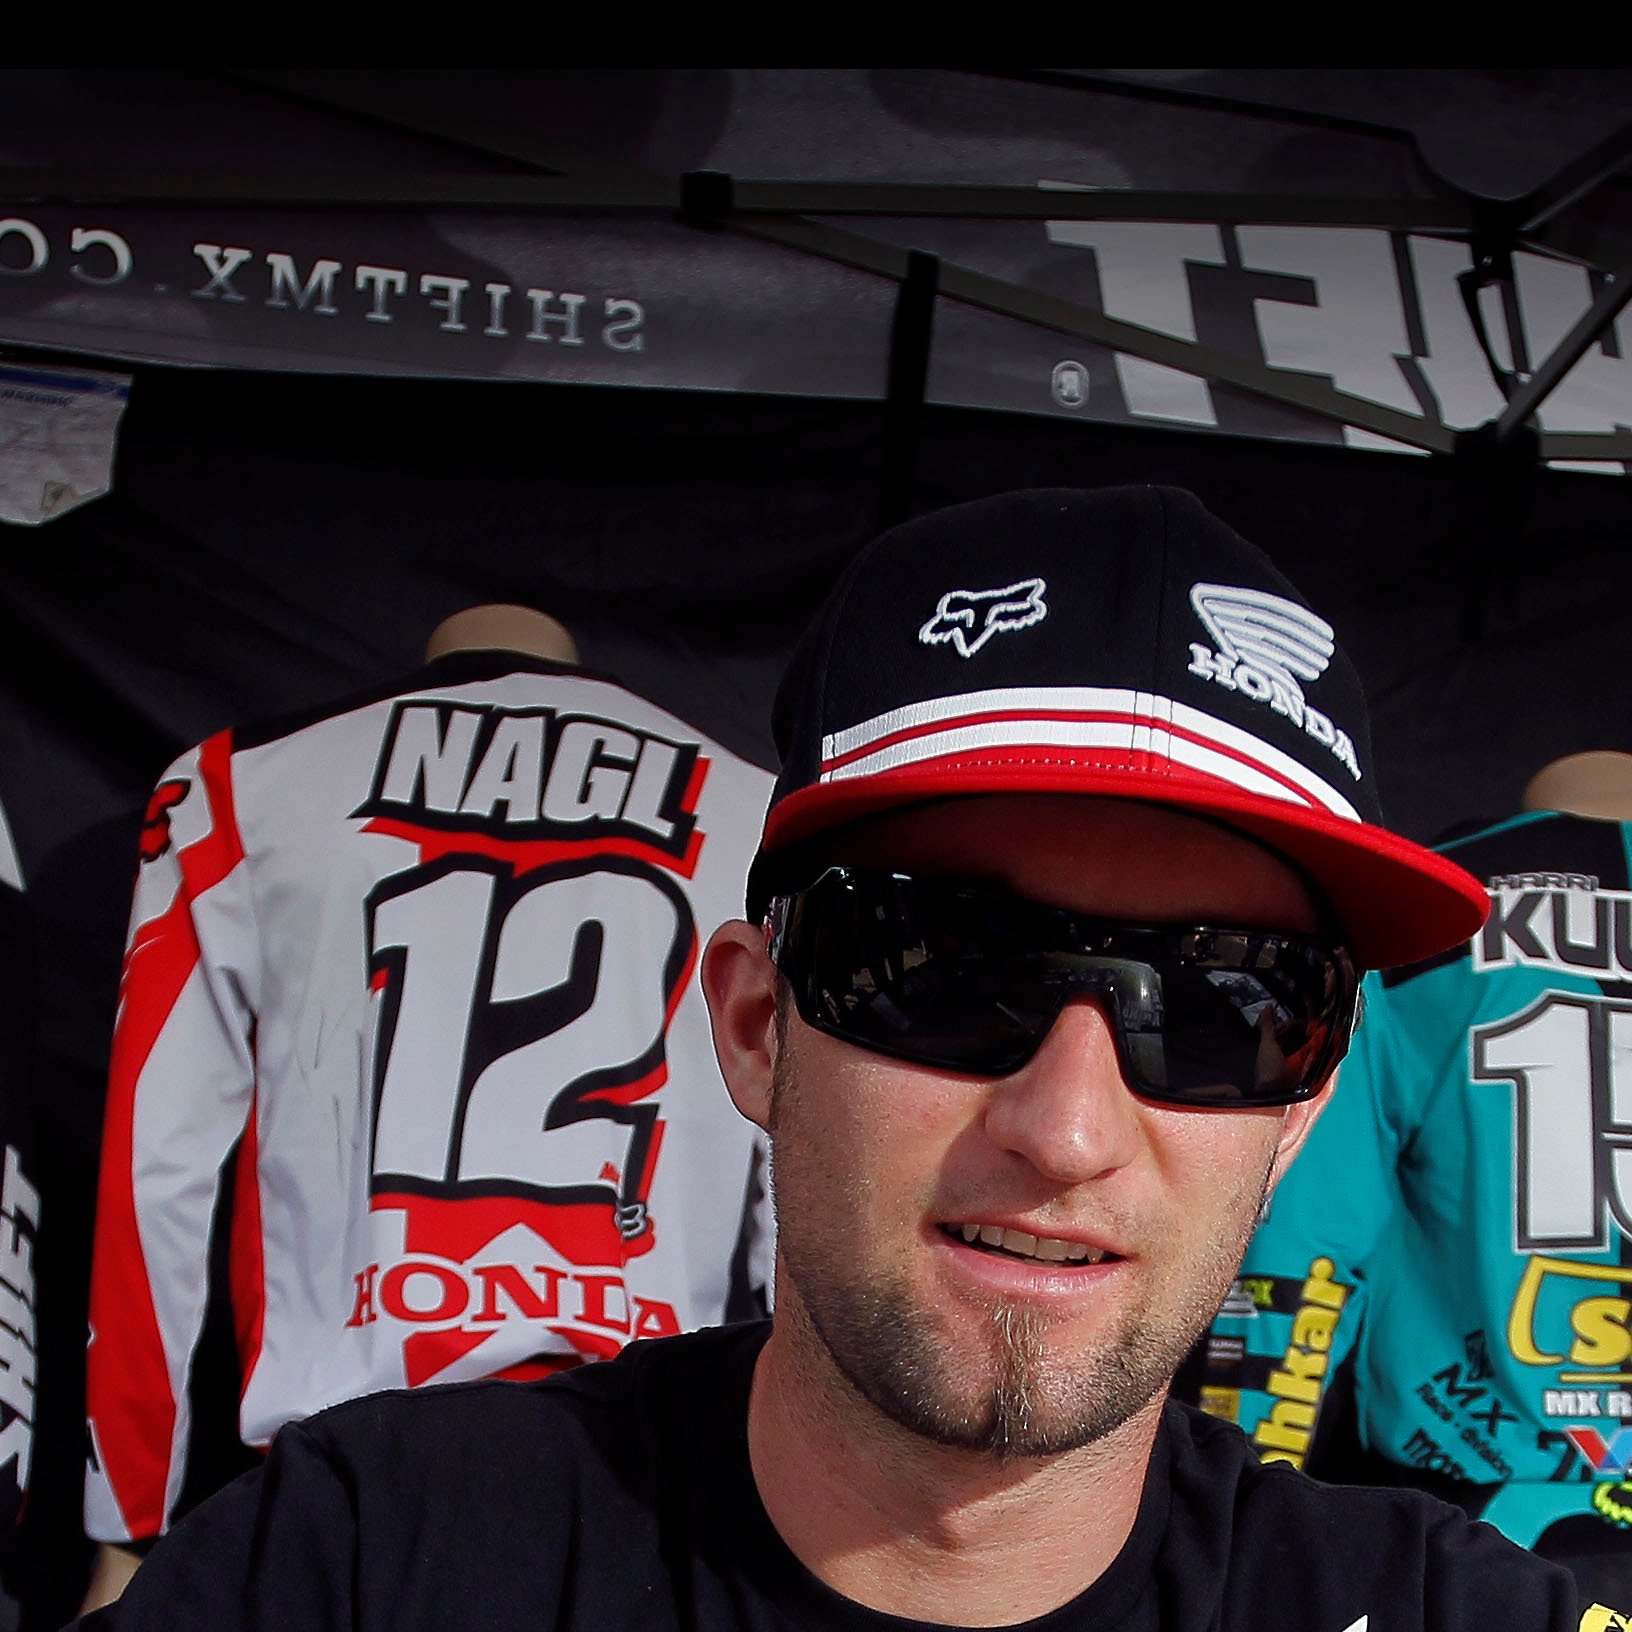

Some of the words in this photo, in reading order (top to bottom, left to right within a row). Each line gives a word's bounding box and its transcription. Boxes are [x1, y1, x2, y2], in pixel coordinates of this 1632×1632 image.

[374, 700, 694, 850] NAGL
[1187, 640, 1362, 781] HONDA
[369, 862, 692, 1192] 12
[344, 1262, 681, 1341] HONDA
[1254, 1256, 1349, 1474] hkar
[1542, 1389, 1601, 1418] MX
